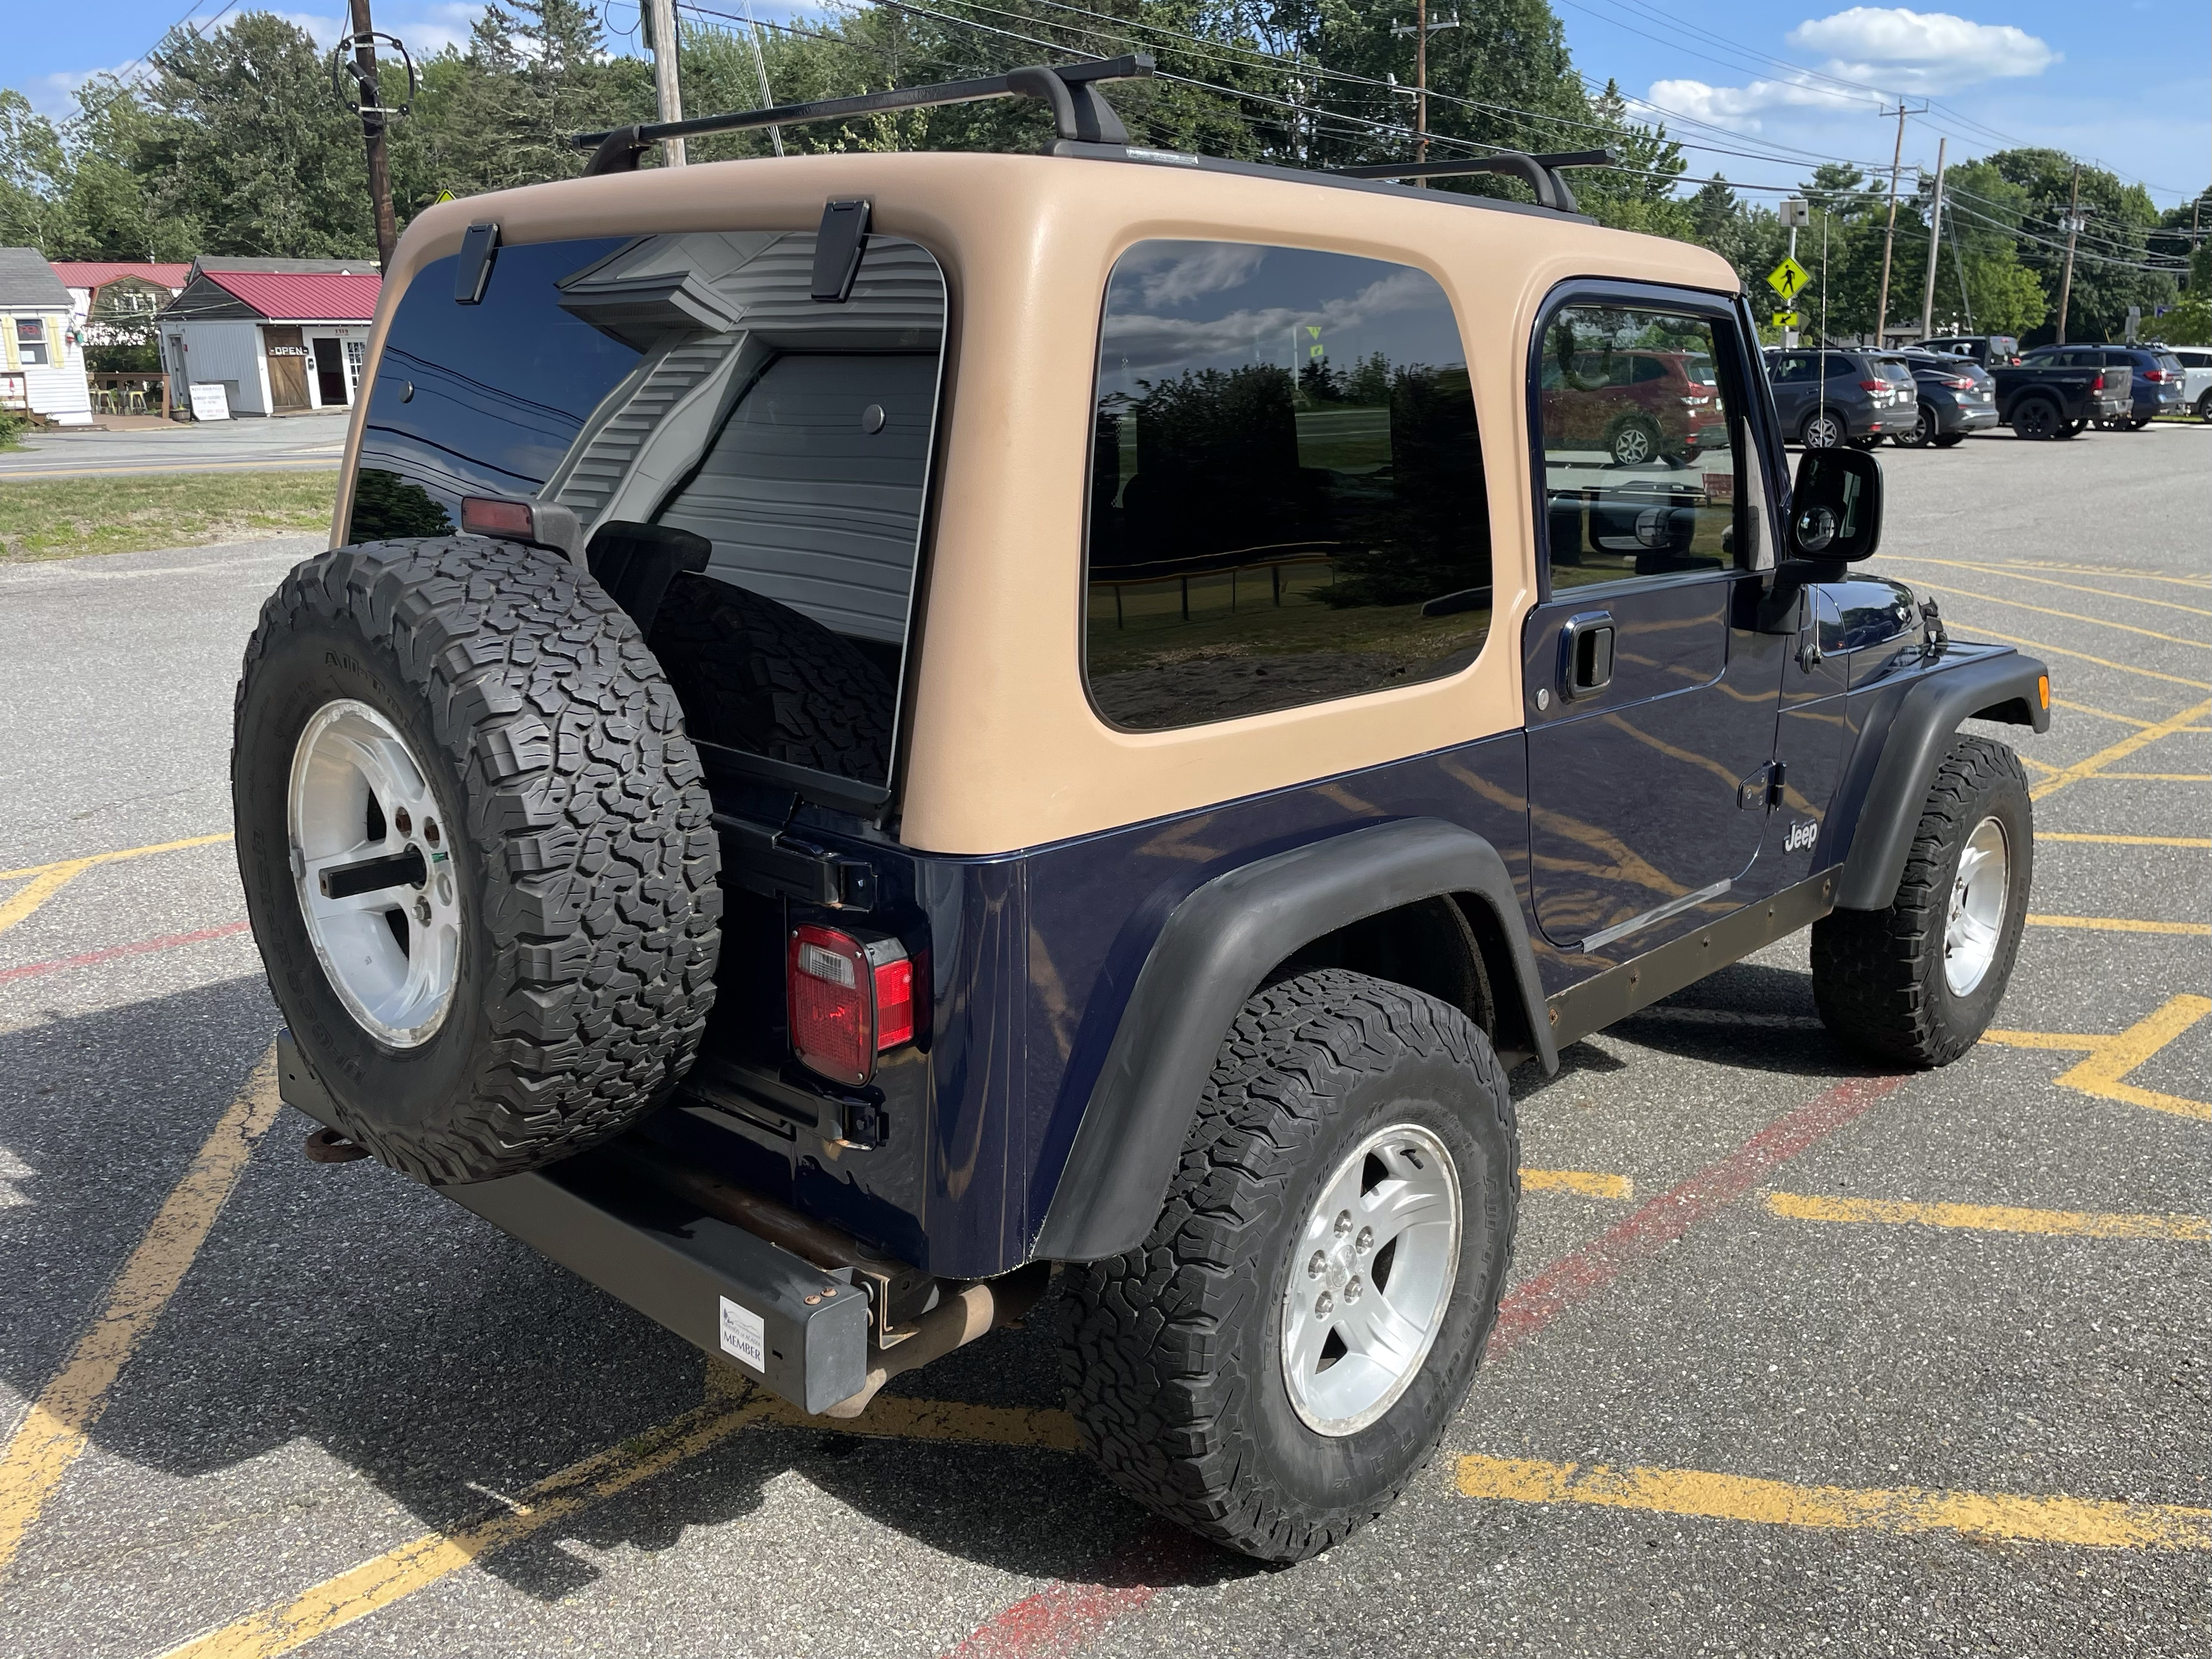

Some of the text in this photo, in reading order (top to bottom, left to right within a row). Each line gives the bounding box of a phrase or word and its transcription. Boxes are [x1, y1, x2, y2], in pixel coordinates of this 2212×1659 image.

[1784, 821, 1818, 853] Jeep
[724, 1330, 760, 1361] MEMBER
[745, 1333, 760, 1348] ACADIA
